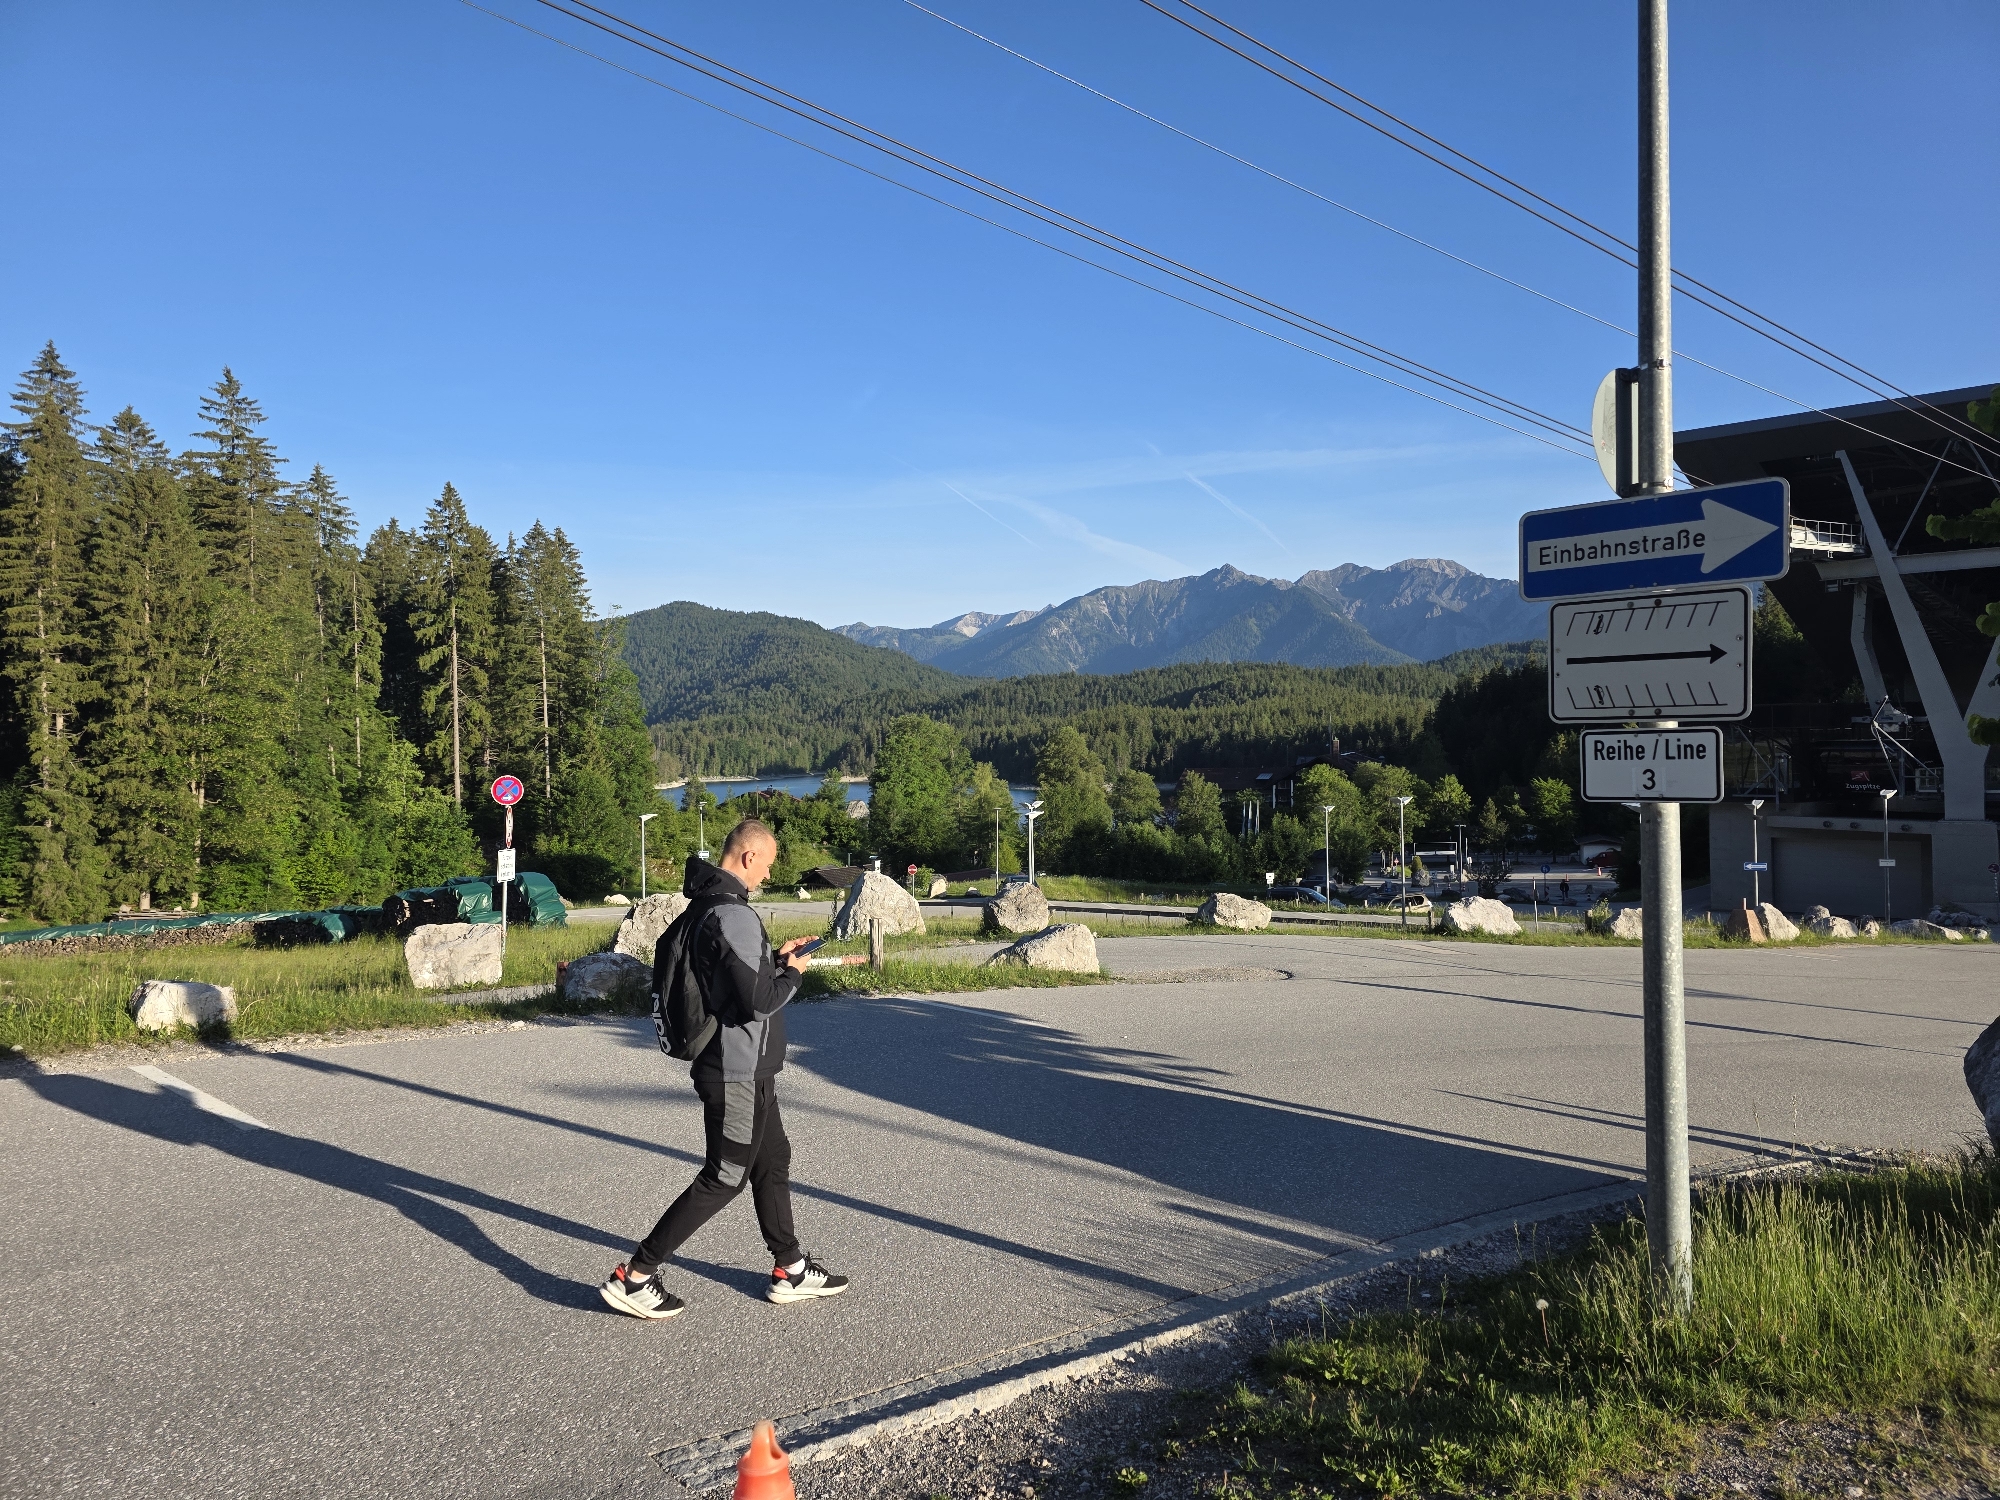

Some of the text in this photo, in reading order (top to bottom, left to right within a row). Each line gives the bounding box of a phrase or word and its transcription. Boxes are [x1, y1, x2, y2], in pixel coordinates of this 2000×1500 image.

[1539, 529, 1706, 565] Einbahnstraße
[1594, 738, 1707, 761] Reihe / Line
[1642, 768, 1656, 791] 3
[1845, 783, 1881, 791] Zugspitze
